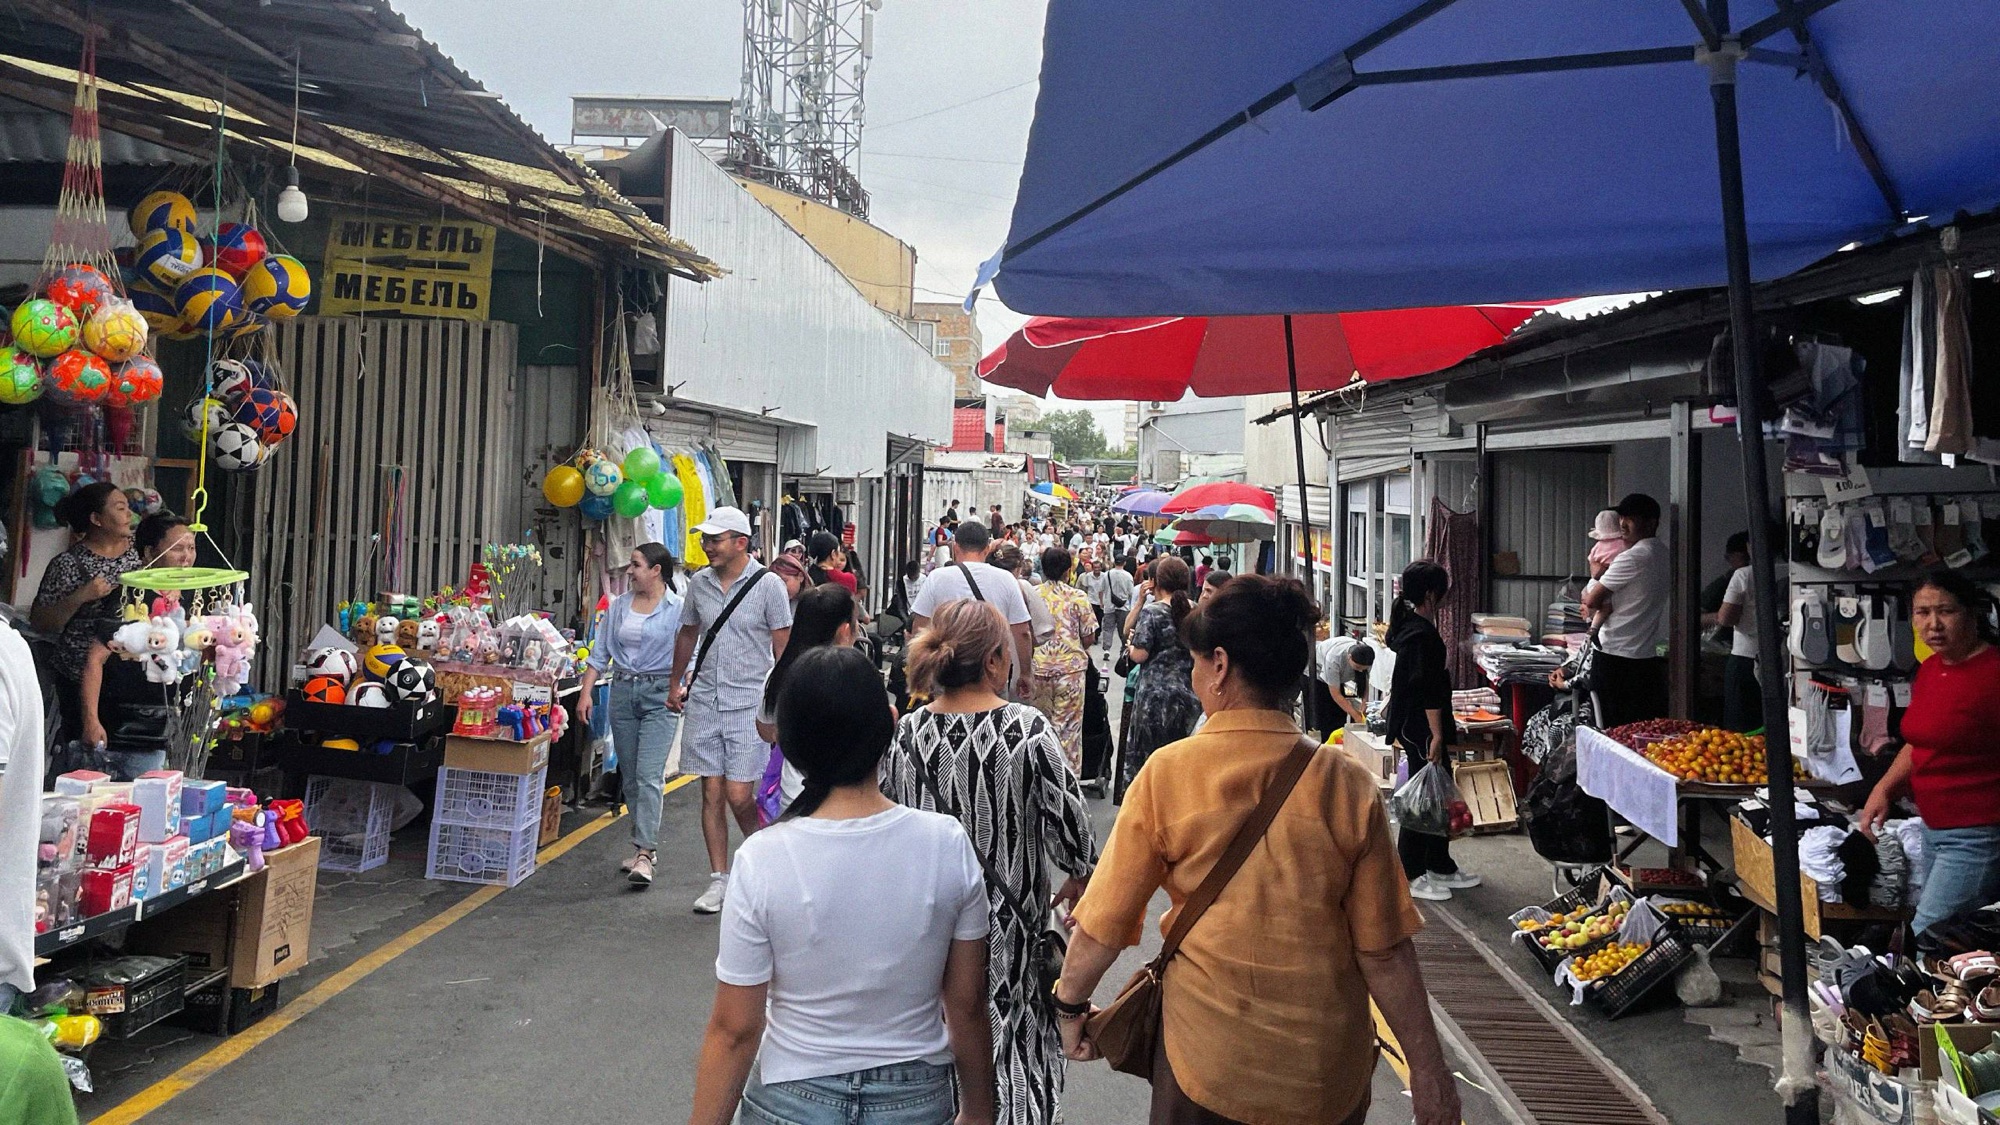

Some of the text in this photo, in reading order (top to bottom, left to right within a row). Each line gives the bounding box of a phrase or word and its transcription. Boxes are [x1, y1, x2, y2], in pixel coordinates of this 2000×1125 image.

[340, 221, 482, 254] МЕБЕЛЬ
[333, 272, 478, 310] МЕБЕЛЬ
[1836, 480, 1853, 492] 100
